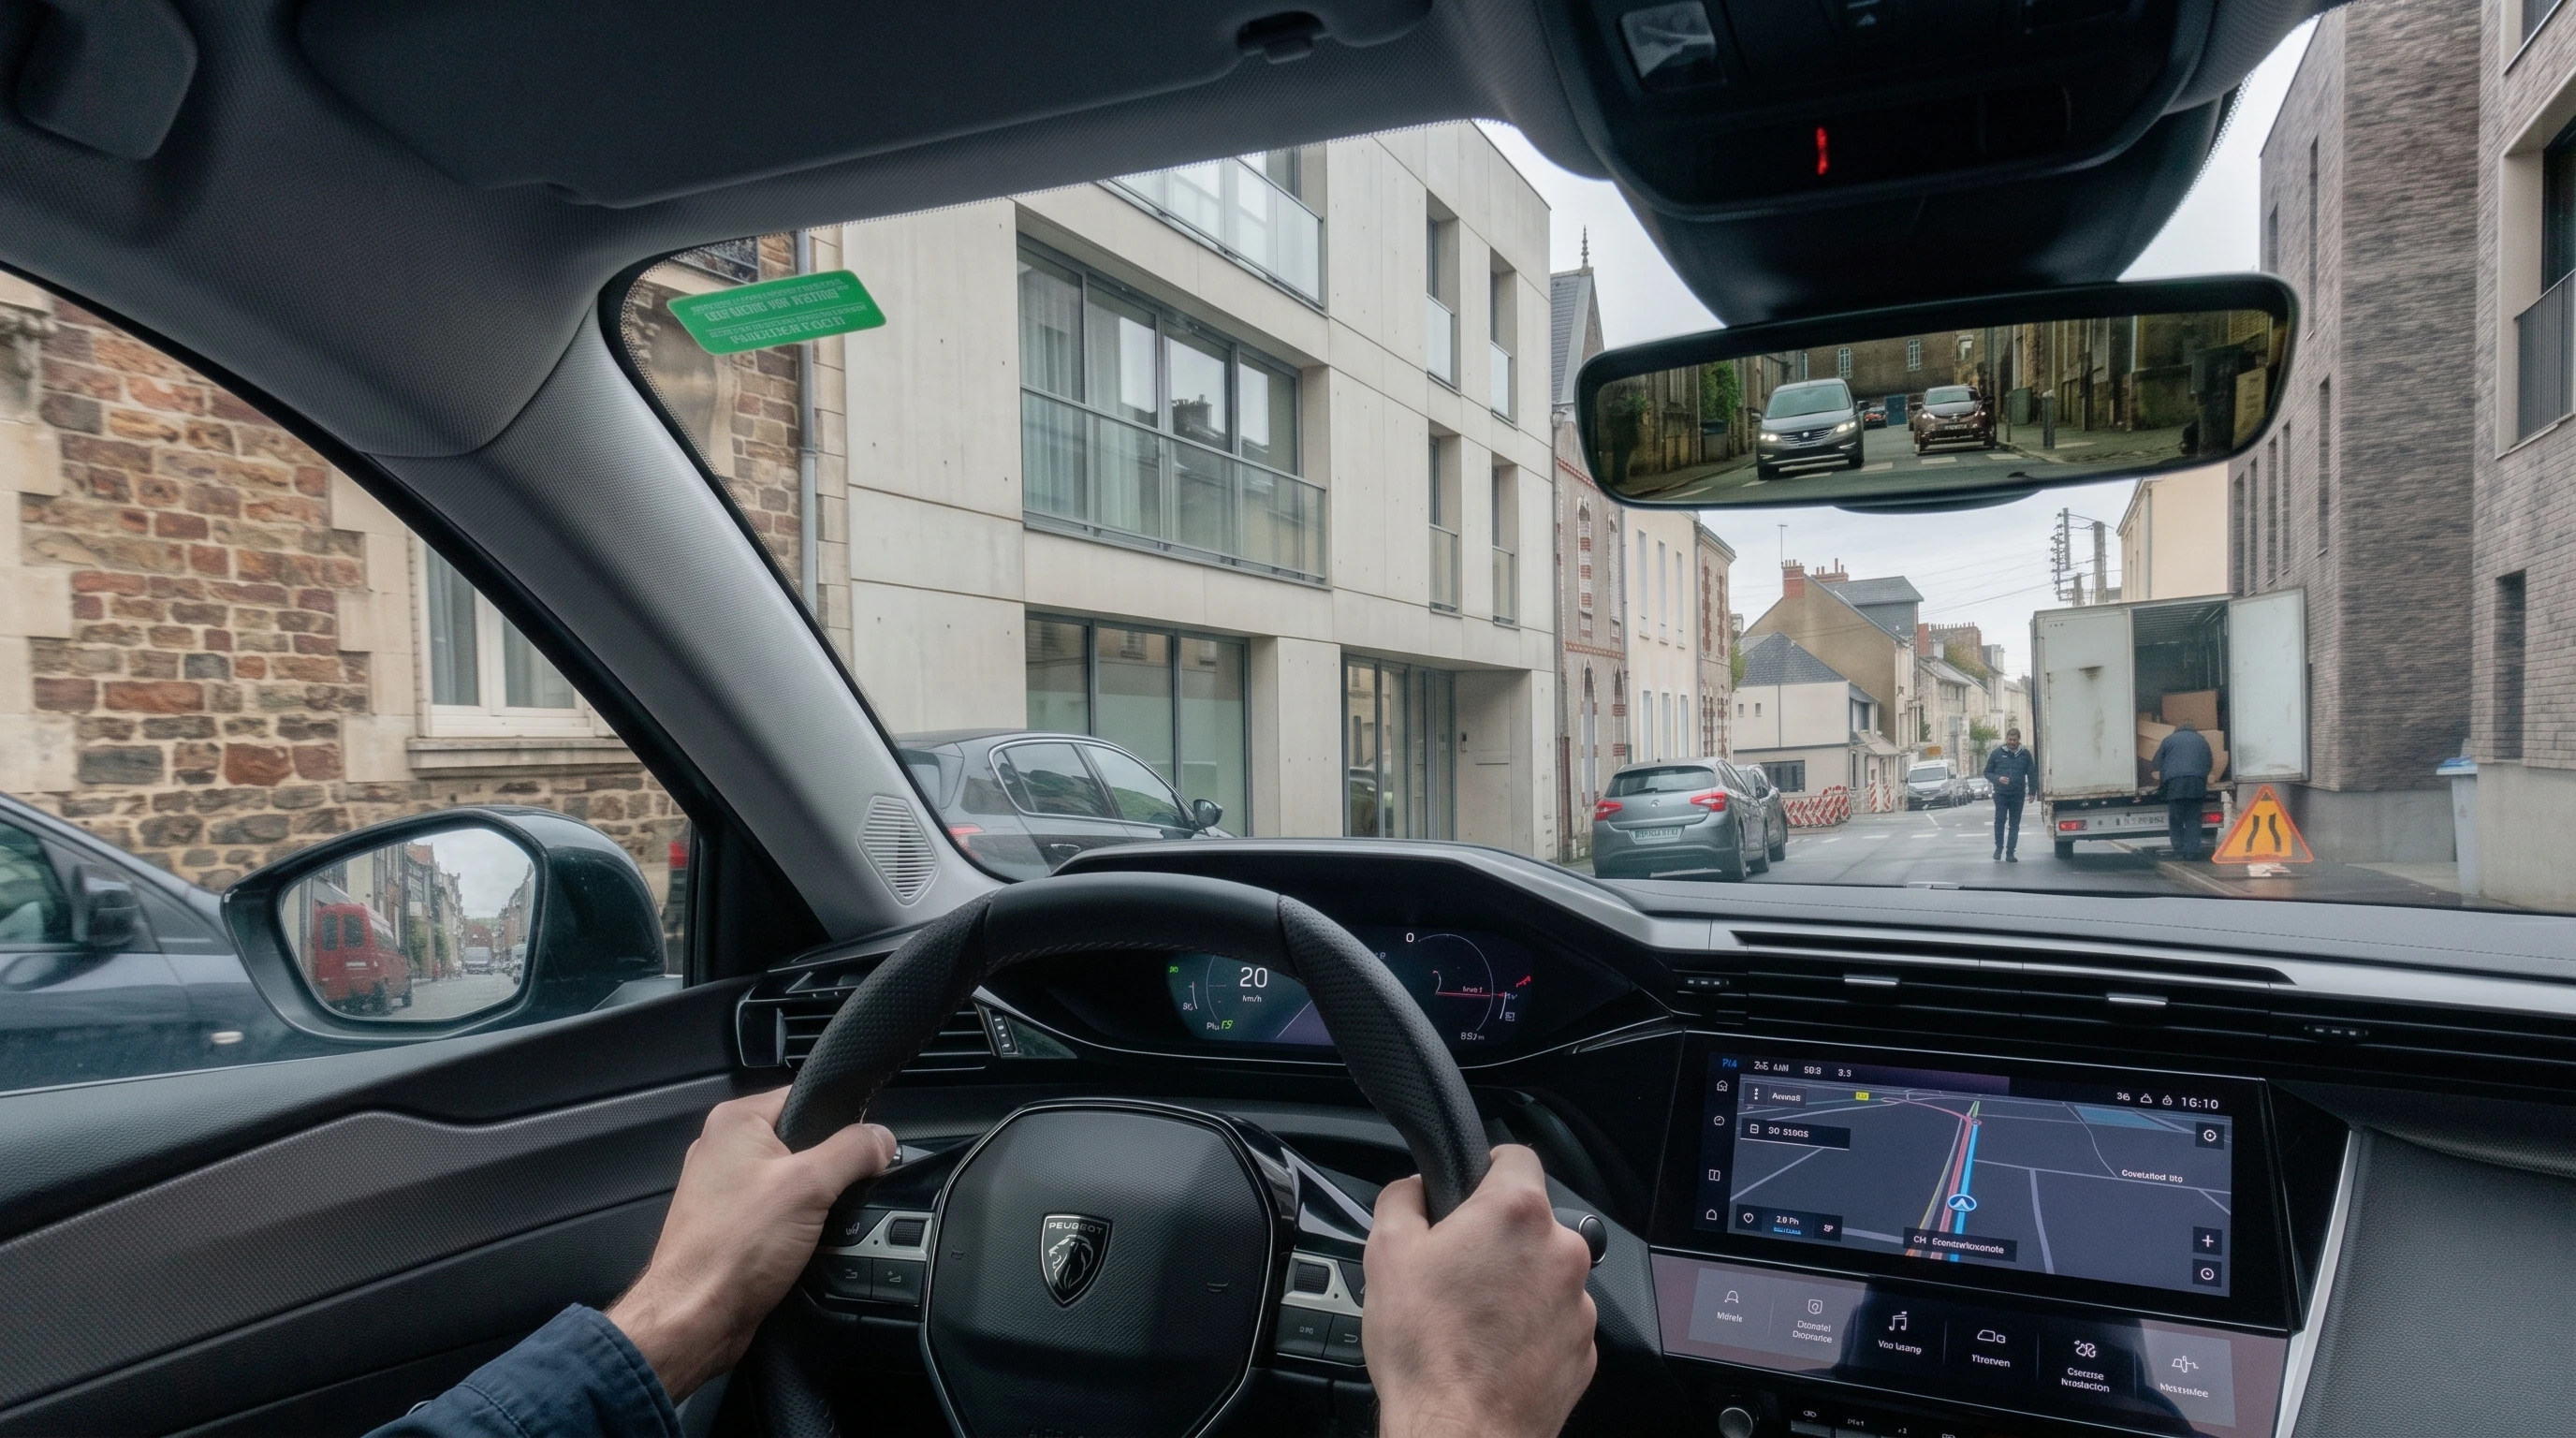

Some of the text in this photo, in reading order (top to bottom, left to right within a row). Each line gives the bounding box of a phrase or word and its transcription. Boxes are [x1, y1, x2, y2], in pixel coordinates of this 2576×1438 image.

[1239, 966, 1268, 988] 20
[2181, 1096, 2219, 1109] 16:10
[1048, 1222, 1103, 1234] PEUGEOT
